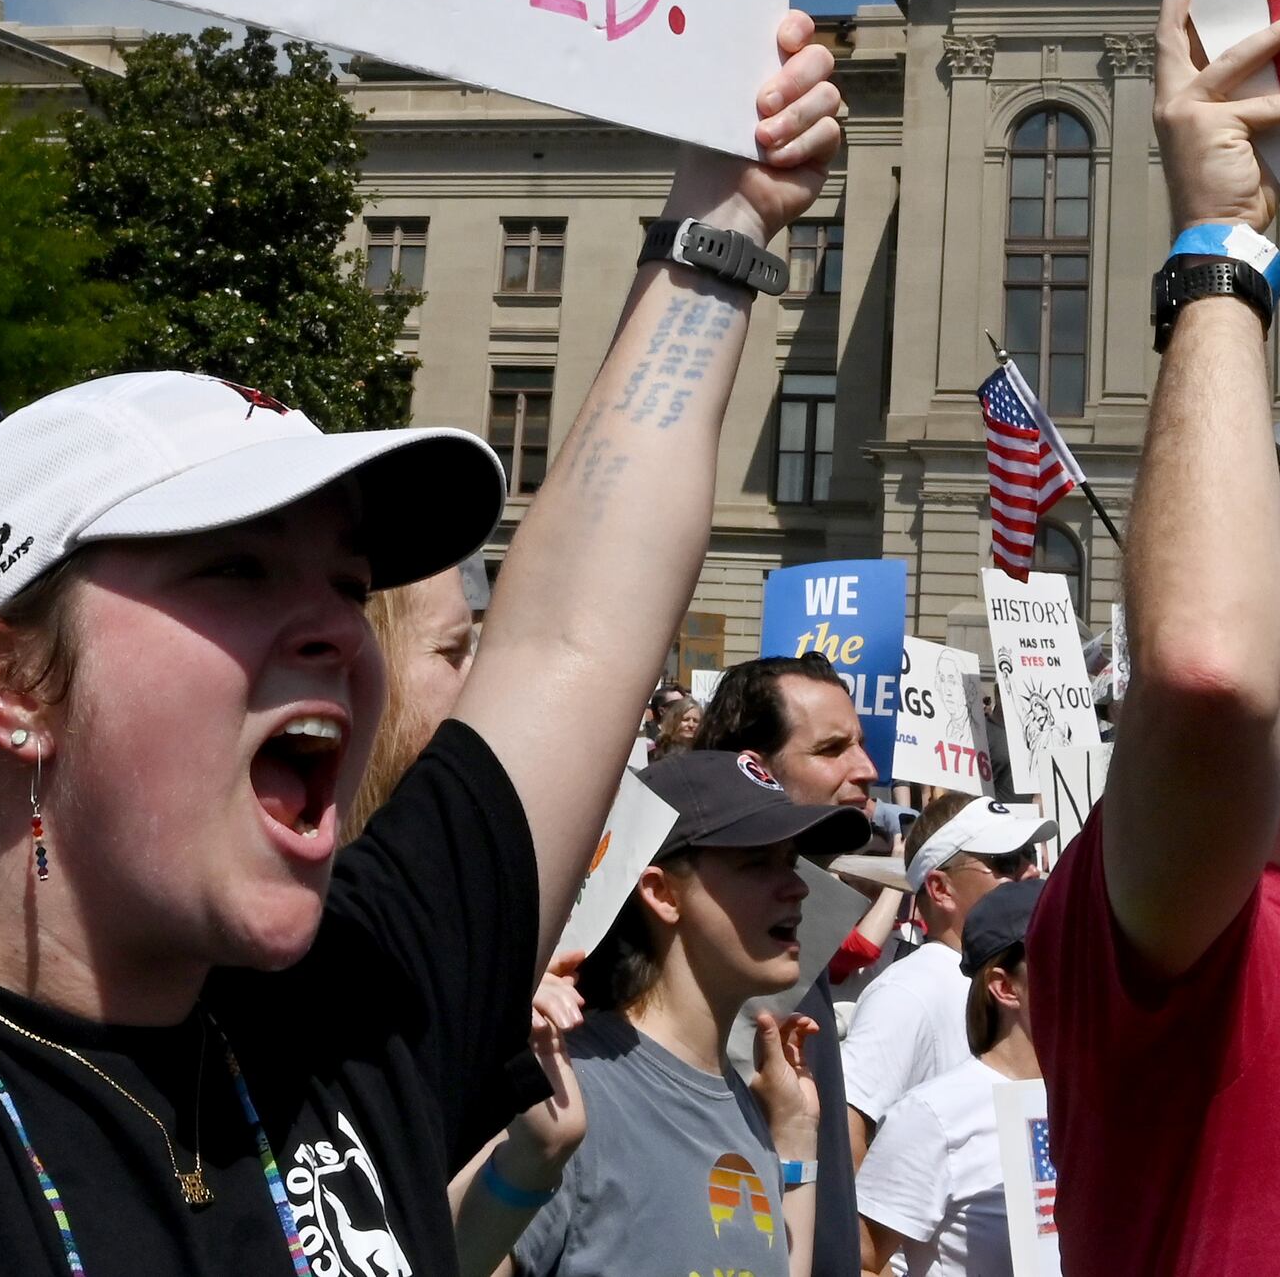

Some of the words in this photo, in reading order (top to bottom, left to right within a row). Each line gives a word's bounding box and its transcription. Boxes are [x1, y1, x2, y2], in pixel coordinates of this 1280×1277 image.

[805, 575, 858, 616] WE
[991, 598, 1070, 626] HISTORY
[795, 622, 864, 664] the
[1019, 637, 1038, 649] HAS
[1040, 638, 1055, 649] ITS
[1020, 656, 1045, 667] EYES
[1047, 656, 1061, 667] ON
[1053, 684, 1092, 709] YOU
[934, 740, 992, 782] 1776
